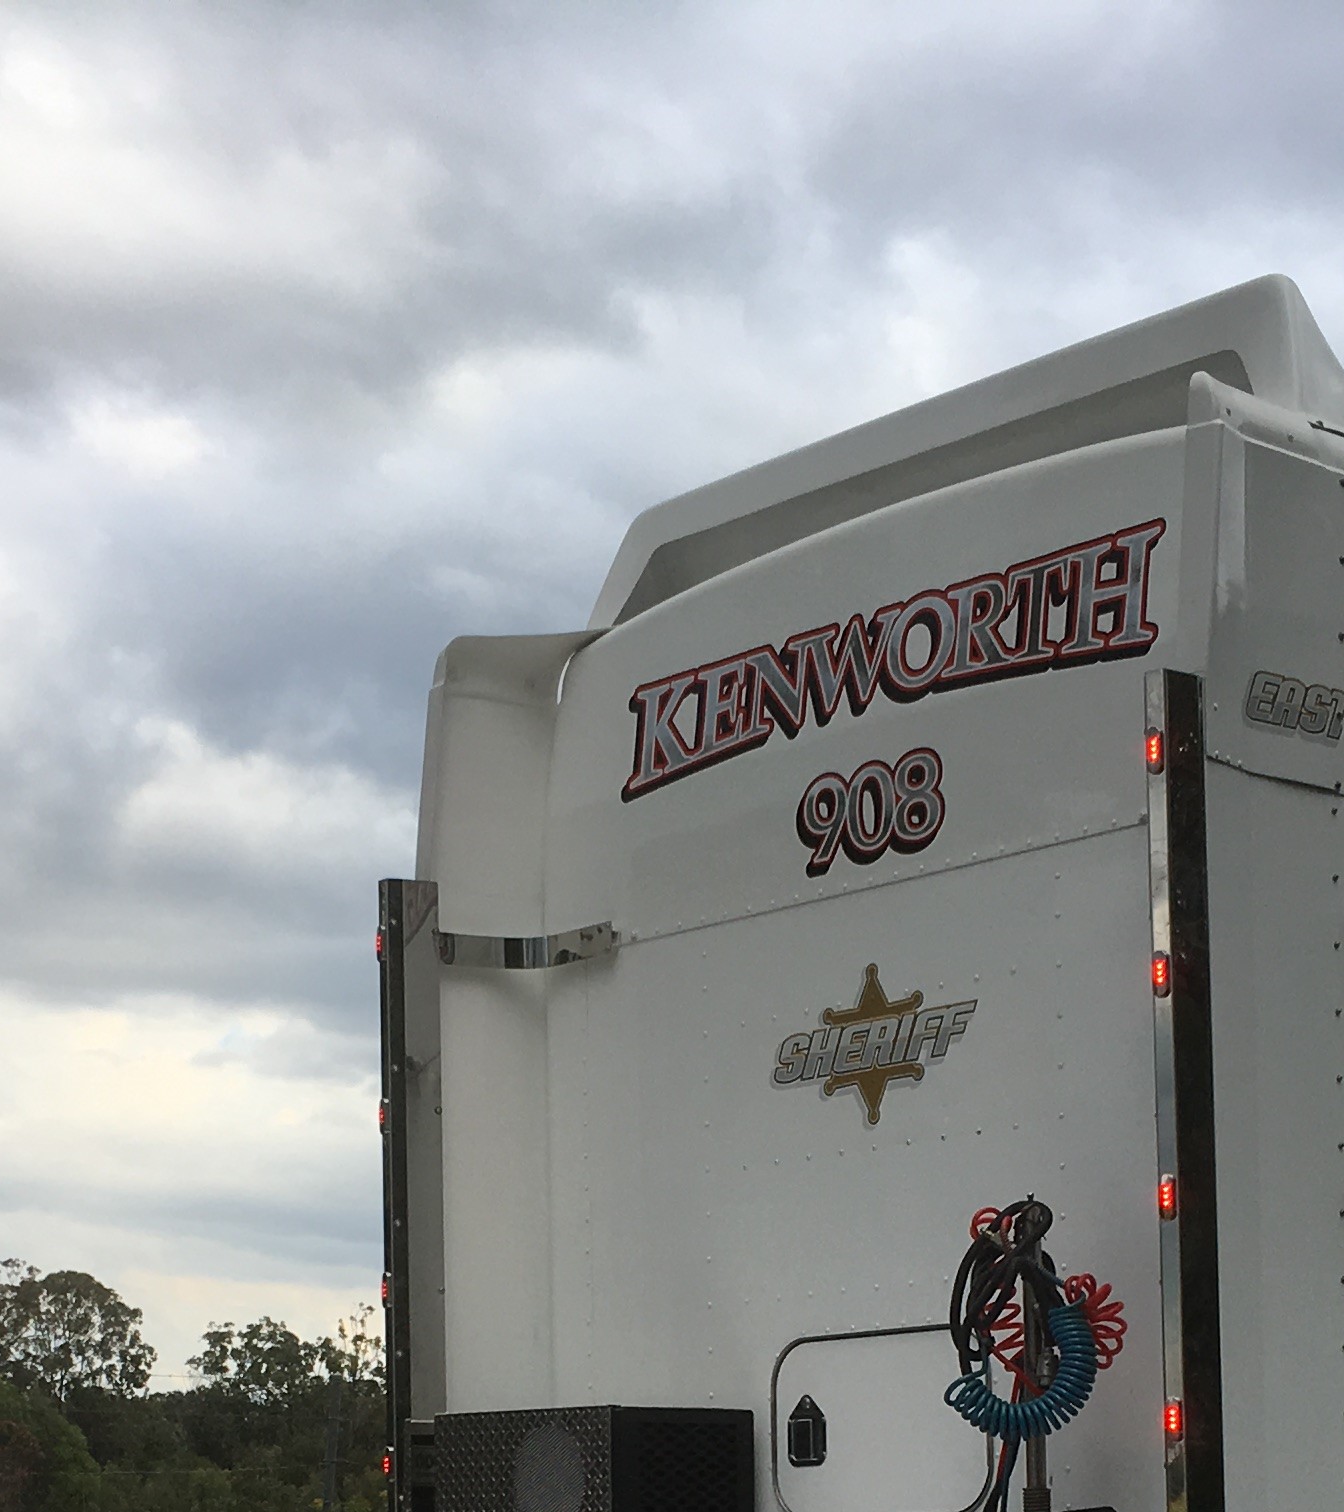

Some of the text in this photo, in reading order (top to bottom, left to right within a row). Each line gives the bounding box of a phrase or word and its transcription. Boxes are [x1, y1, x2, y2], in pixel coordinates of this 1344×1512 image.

[622, 517, 1166, 803] KENWORTH
[796, 747, 946, 878] 908
[773, 998, 979, 1084] SHERIFF
